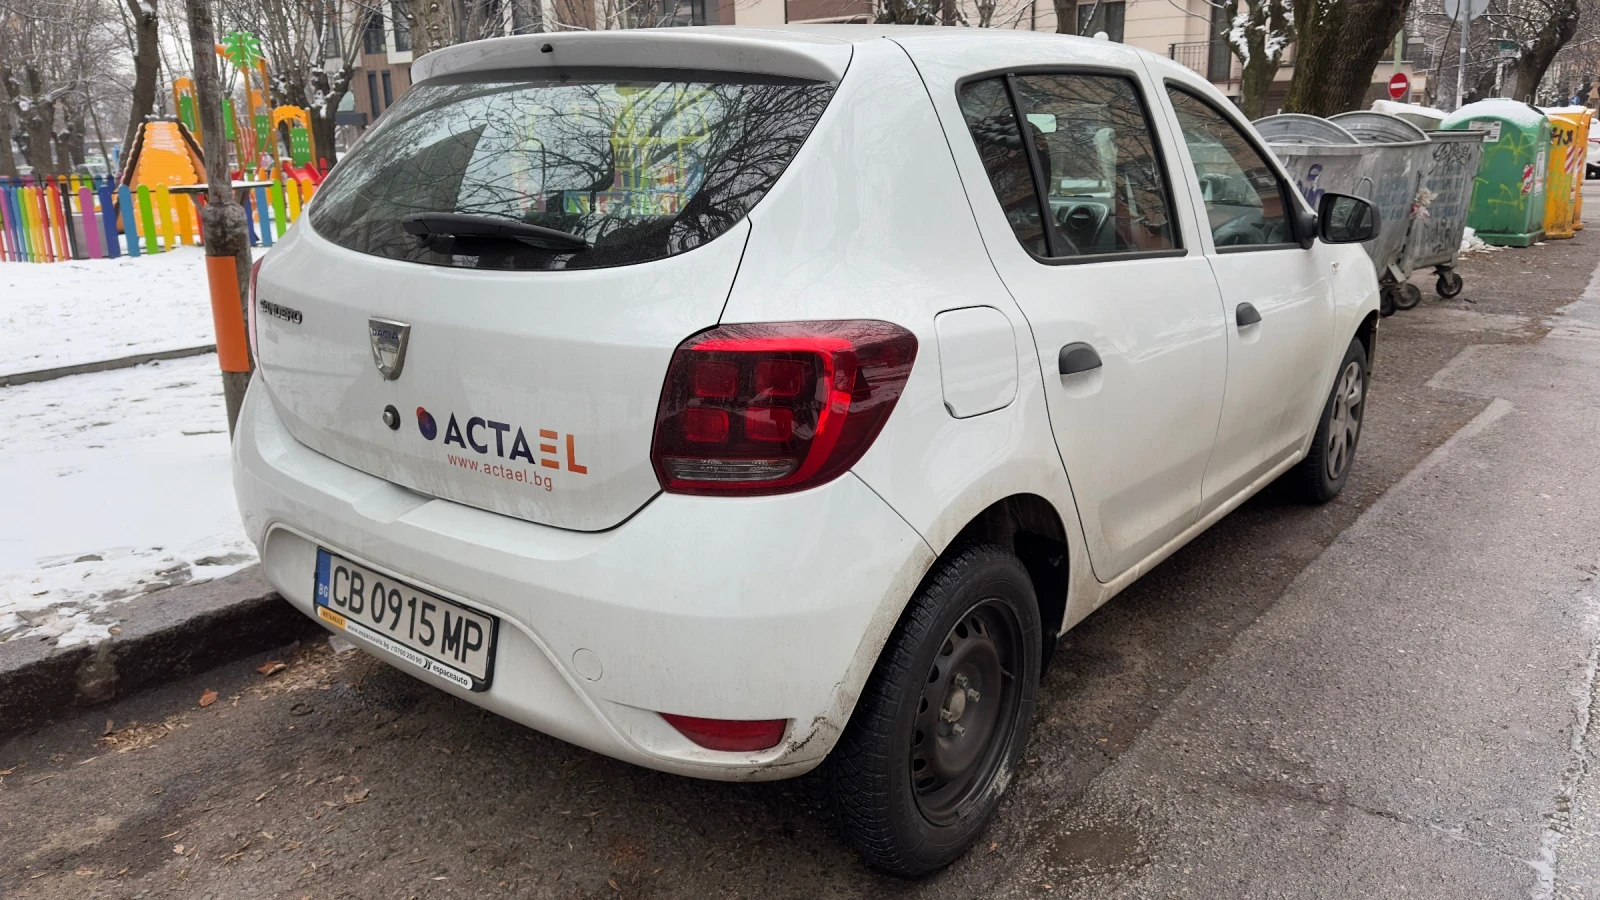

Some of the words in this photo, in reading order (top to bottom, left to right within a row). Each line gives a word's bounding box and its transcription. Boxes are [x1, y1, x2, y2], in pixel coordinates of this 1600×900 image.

[259, 299, 303, 324] SANDERO
[372, 328, 398, 340] DACIA
[444, 412, 588, 475] ACTAEL
[447, 453, 553, 492] www.actael.bg
[318, 583, 329, 598] BG
[322, 610, 343, 626] RENAULT
[333, 565, 365, 615] CB
[371, 581, 437, 647] 0915
[440, 610, 484, 664] MP
[433, 664, 468, 686] espaceauto
